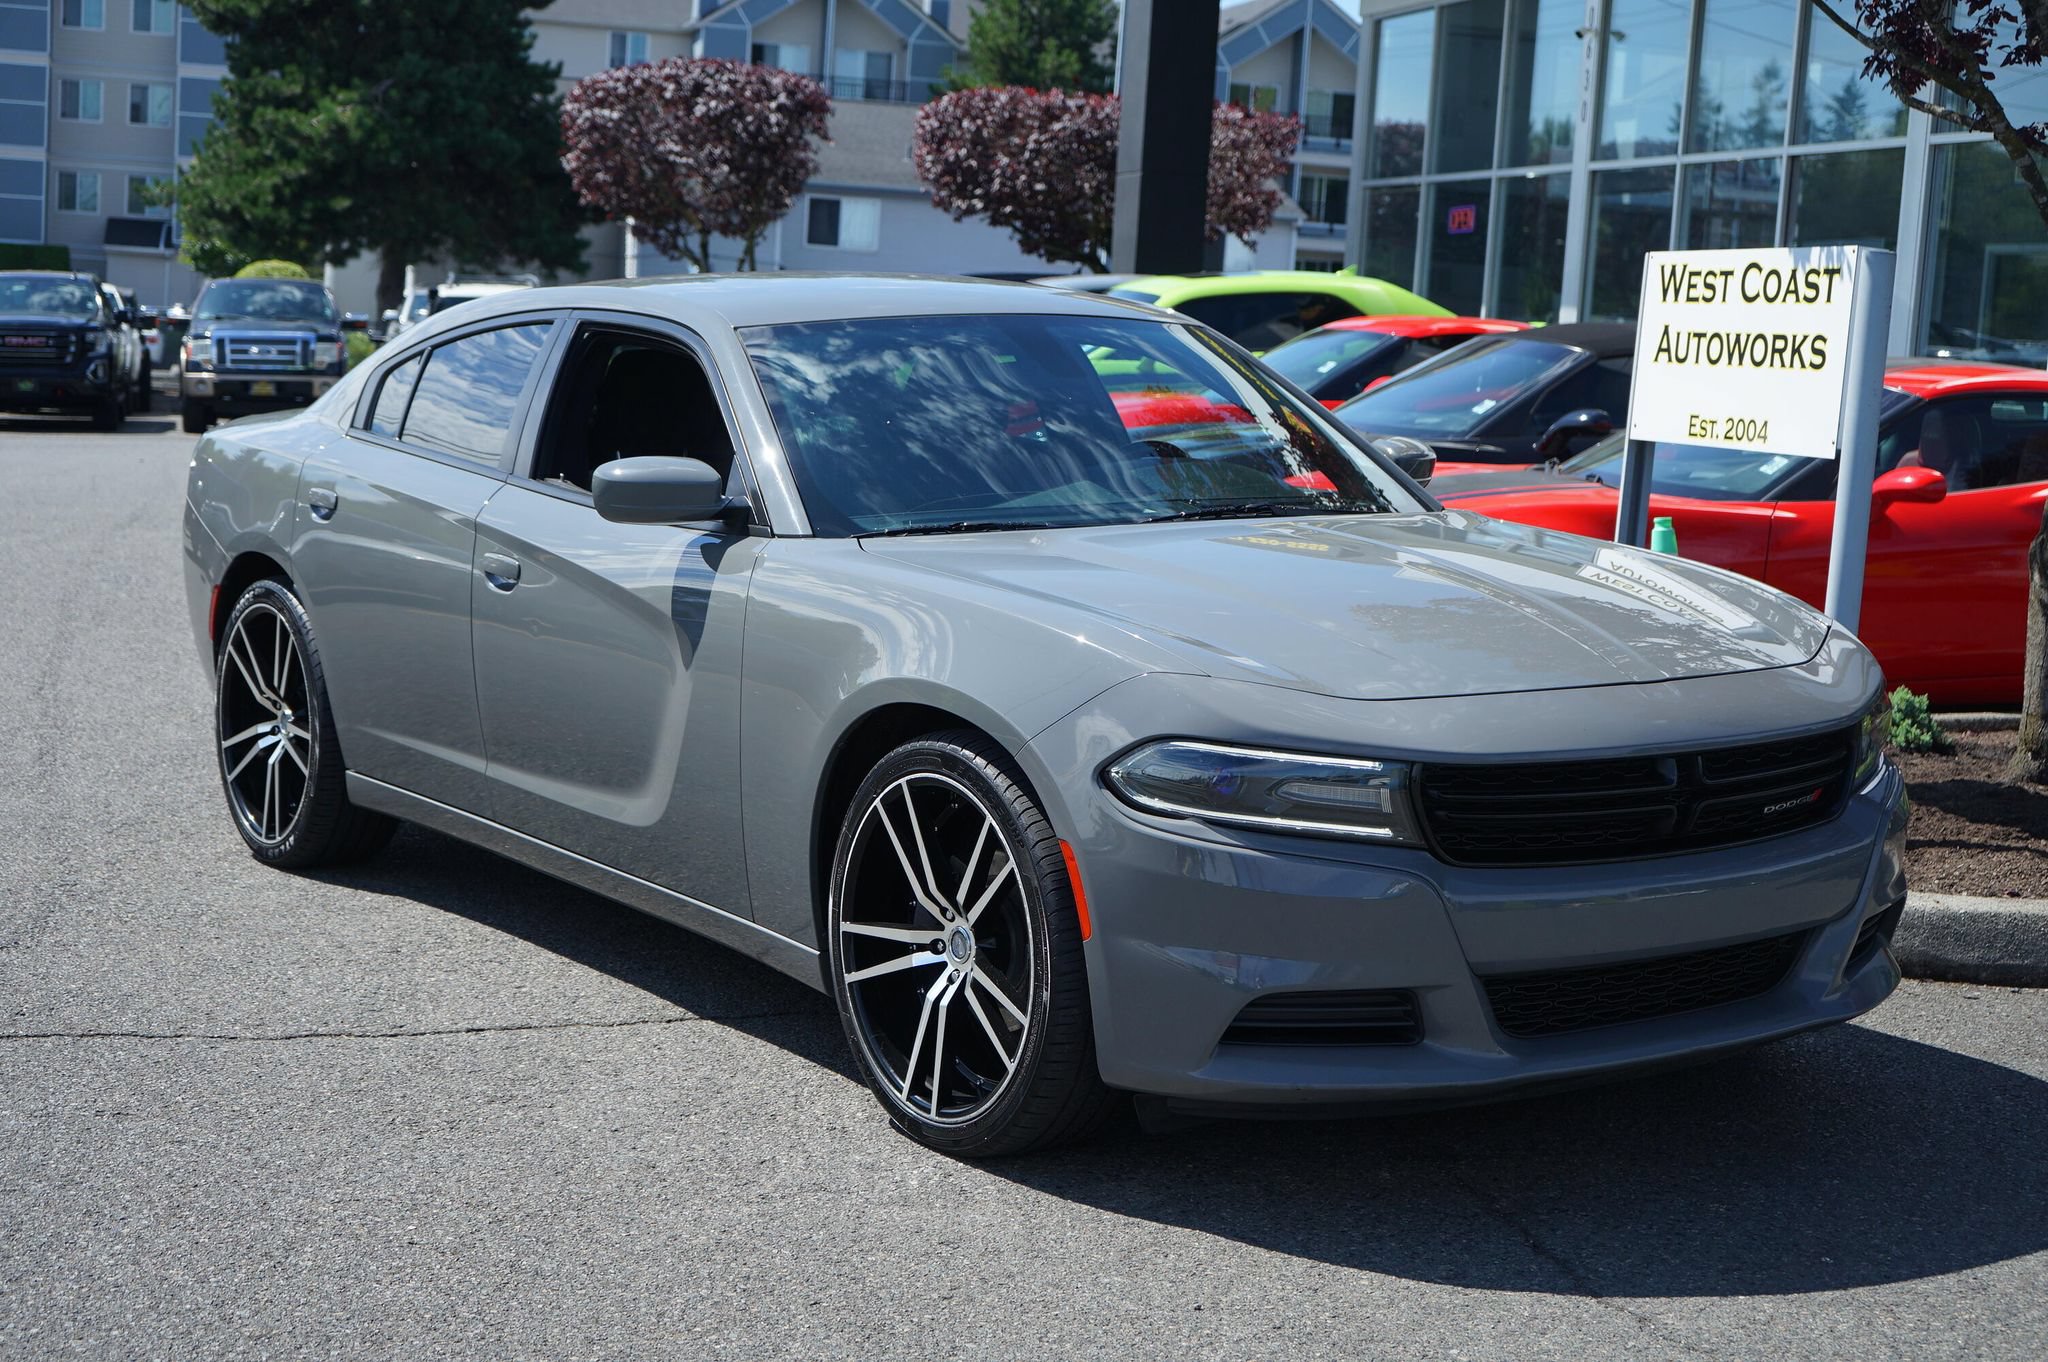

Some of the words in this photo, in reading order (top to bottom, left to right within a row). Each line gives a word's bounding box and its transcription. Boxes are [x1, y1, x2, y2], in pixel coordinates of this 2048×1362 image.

[1660, 264, 1734, 303] WEST
[1740, 262, 1840, 304] COAST
[1654, 325, 1828, 370] AUTOWORKS
[1724, 418, 1768, 444] 2004
